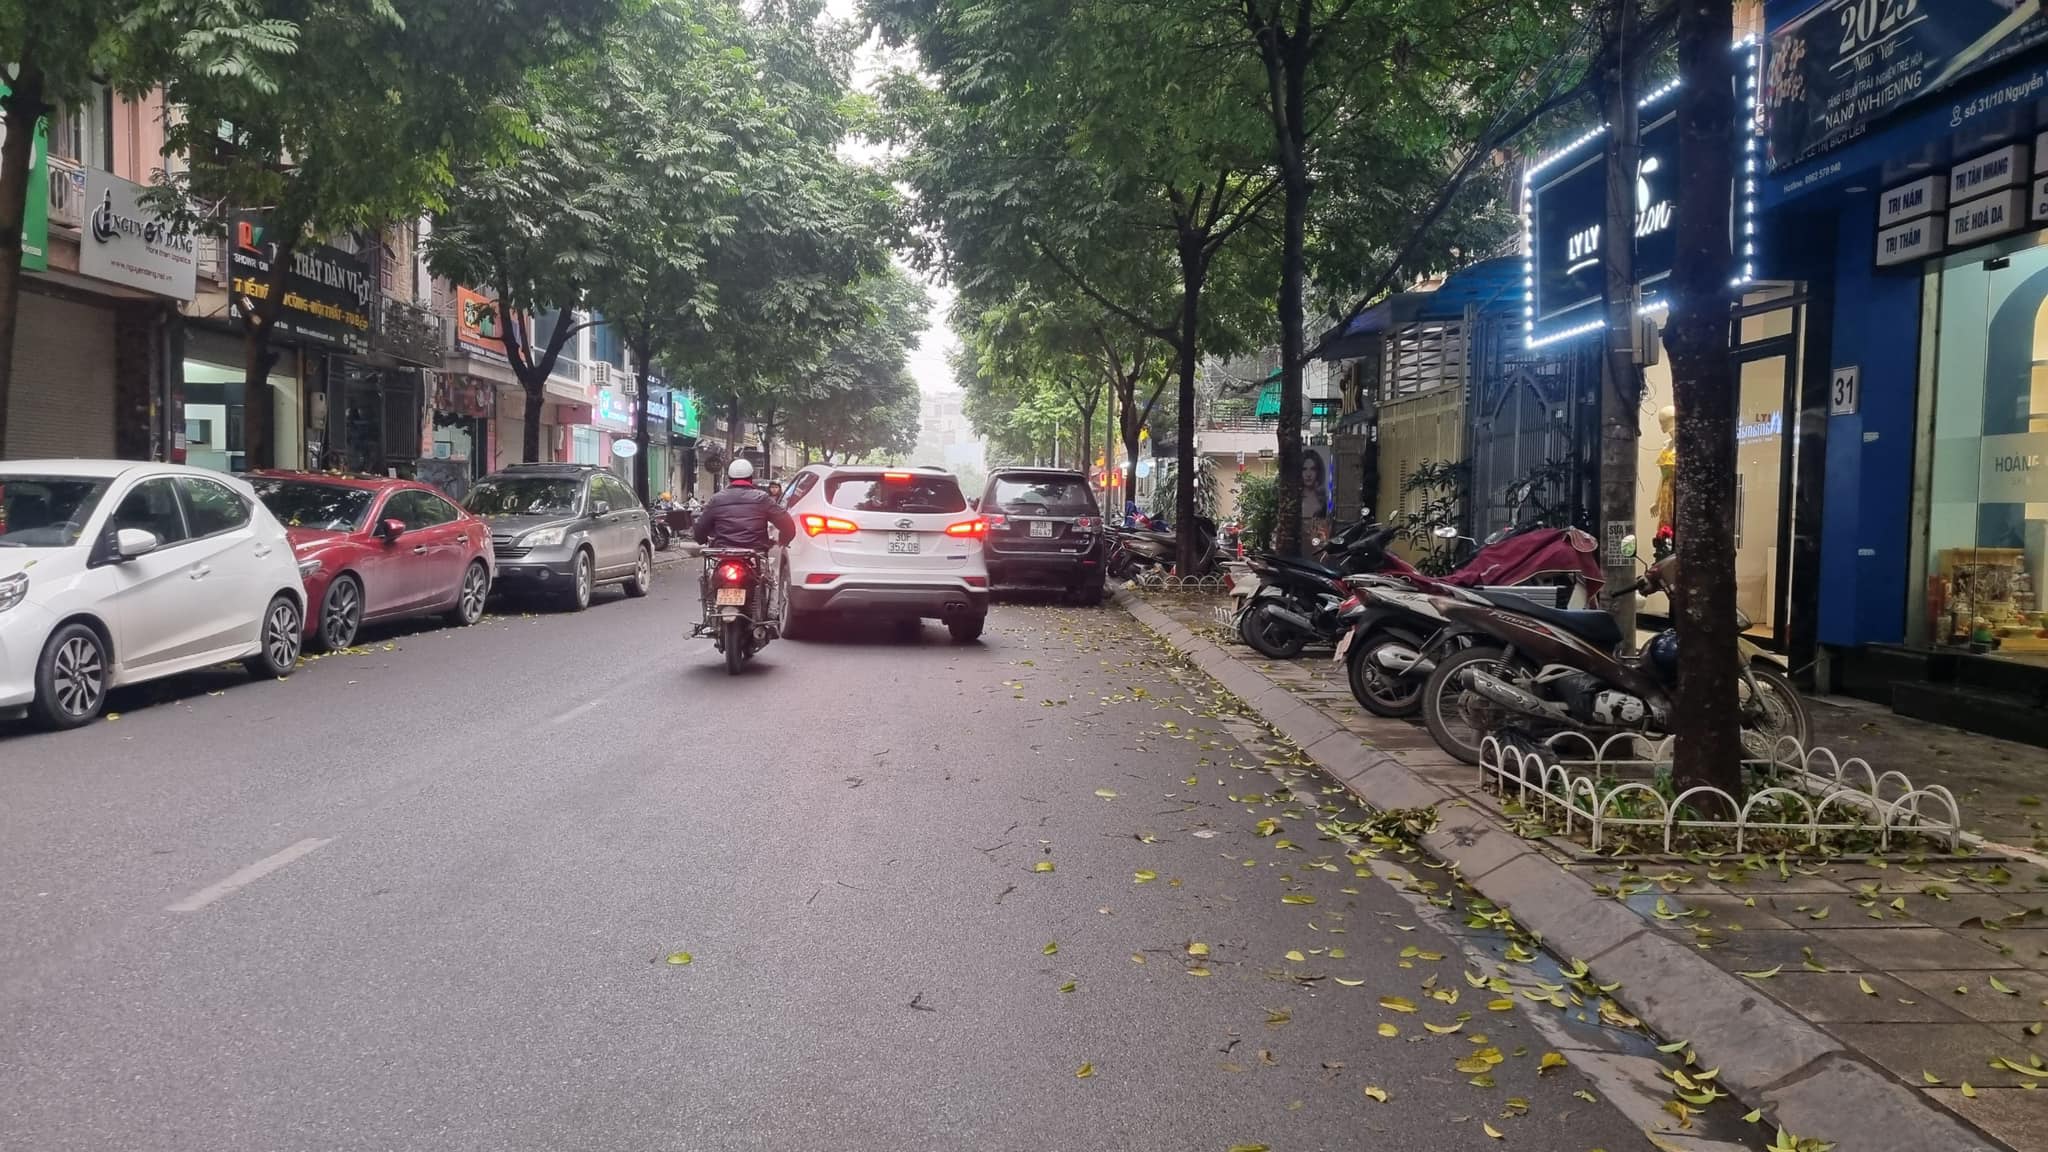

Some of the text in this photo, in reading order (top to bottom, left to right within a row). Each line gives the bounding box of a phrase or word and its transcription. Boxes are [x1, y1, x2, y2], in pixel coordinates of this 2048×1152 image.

[1854, 39, 1896, 72] New Year
[1825, 70, 1923, 130] NANO WHITENING
[1888, 195, 1901, 215] TRỊ
[1991, 205, 2004, 225] DA
[1568, 223, 1601, 261] LYLY
[1885, 235, 1898, 255] TRỊ
[1834, 375, 1854, 406] 31
[895, 531, 912, 541] 30F
